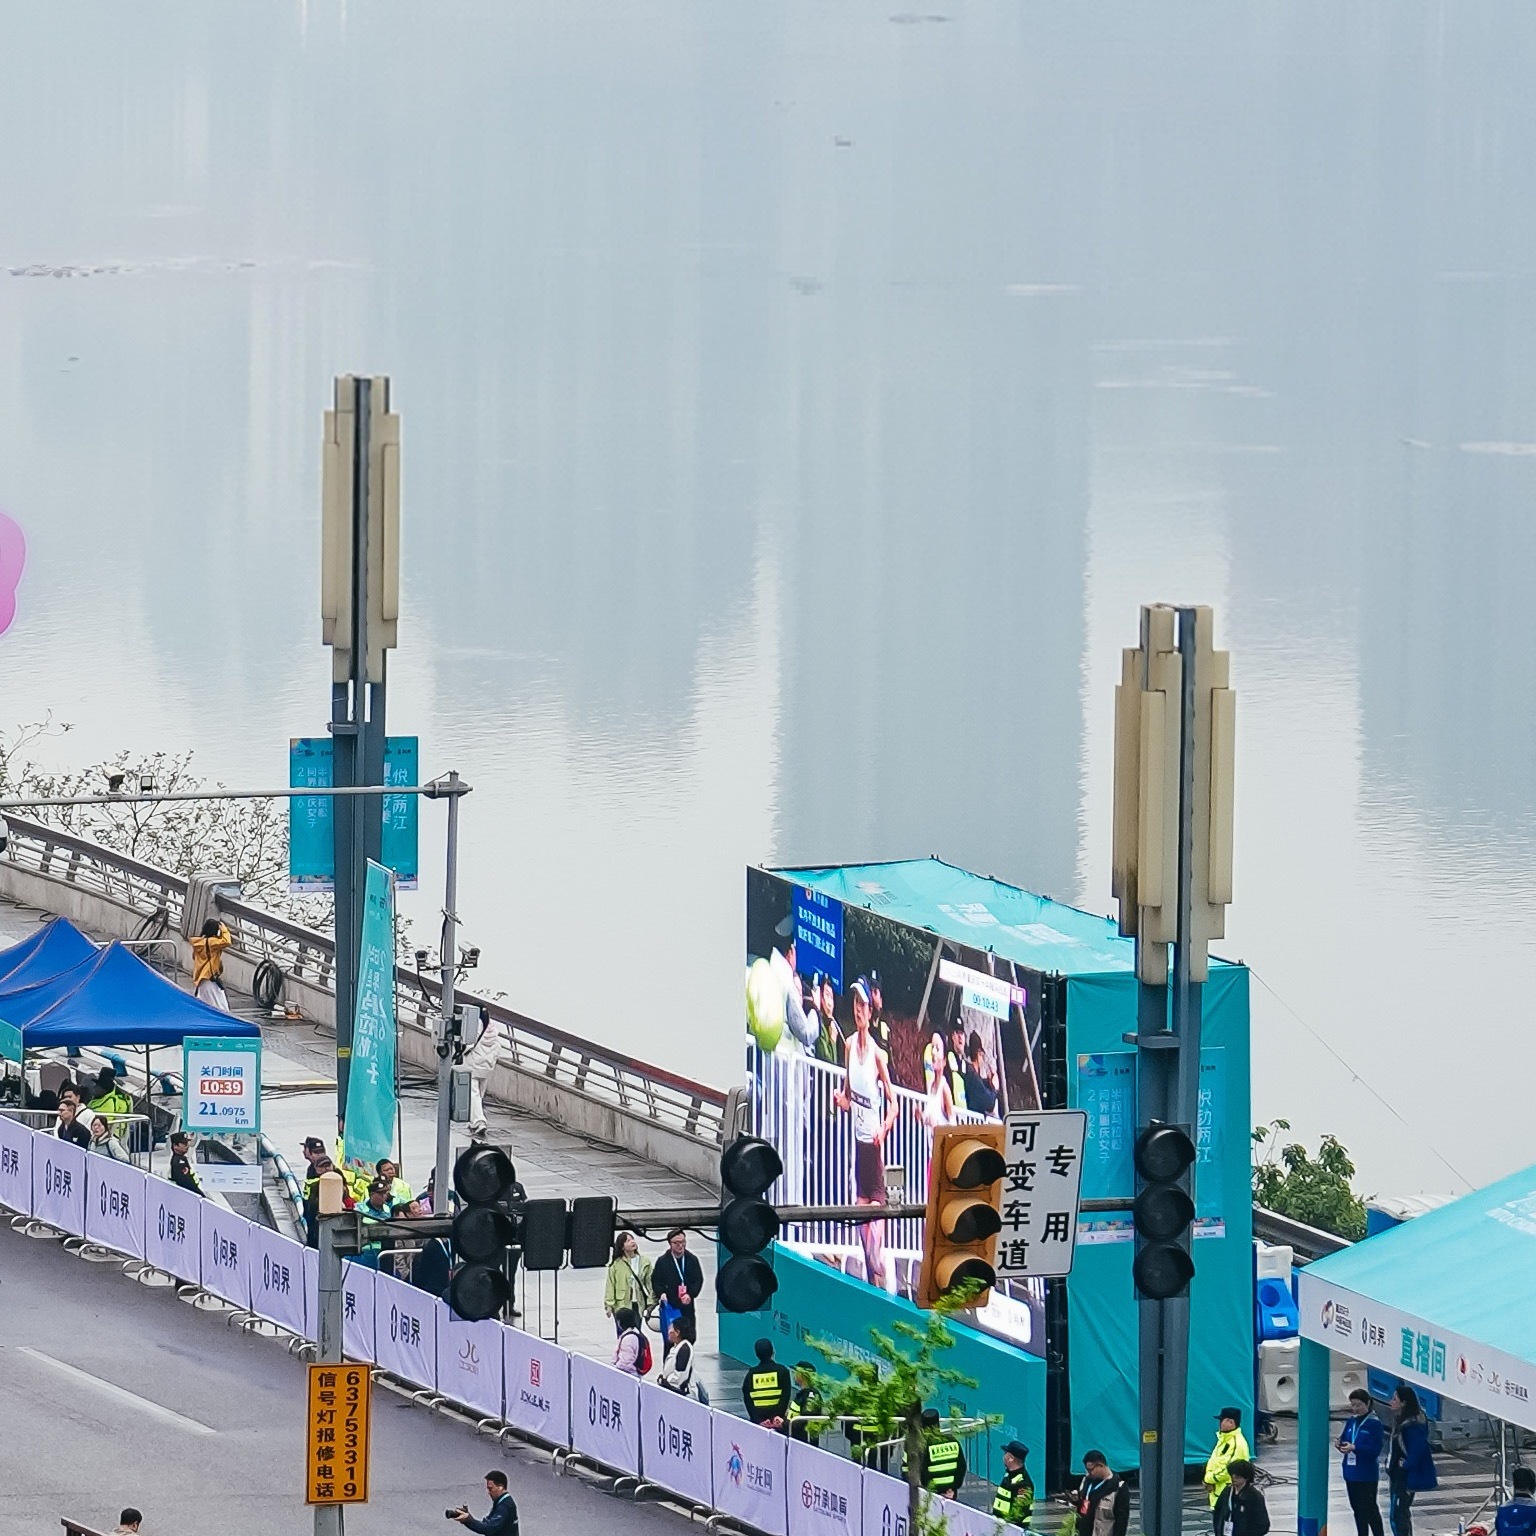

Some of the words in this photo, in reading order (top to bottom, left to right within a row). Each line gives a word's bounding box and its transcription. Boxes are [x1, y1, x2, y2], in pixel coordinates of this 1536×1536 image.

[201, 1066, 243, 1077] 关门时间
[202, 1082, 241, 1093] 10:39
[199, 1102, 245, 1116] 21.0975
[1, 1144, 18, 1176] 问界
[53, 1165, 72, 1199] 问界
[997, 1121, 1040, 1271] 可变车道
[1041, 1145, 1076, 1244] 专用
[109, 1187, 129, 1219] 问界
[166, 1210, 185, 1244] 问界
[219, 1236, 237, 1271] 问界
[272, 1261, 290, 1296] 问界
[345, 1291, 356, 1321] 界
[401, 1312, 420, 1348] 问界
[1369, 1323, 1385, 1348] 问界
[1401, 1327, 1446, 1382] 直播间
[599, 1394, 623, 1433] 问界
[316, 1372, 337, 1498] 信号灯报修电话
[343, 1371, 360, 1497] 63753319
[669, 1421, 693, 1463] 问界
[747, 1461, 773, 1491] 华龙网
